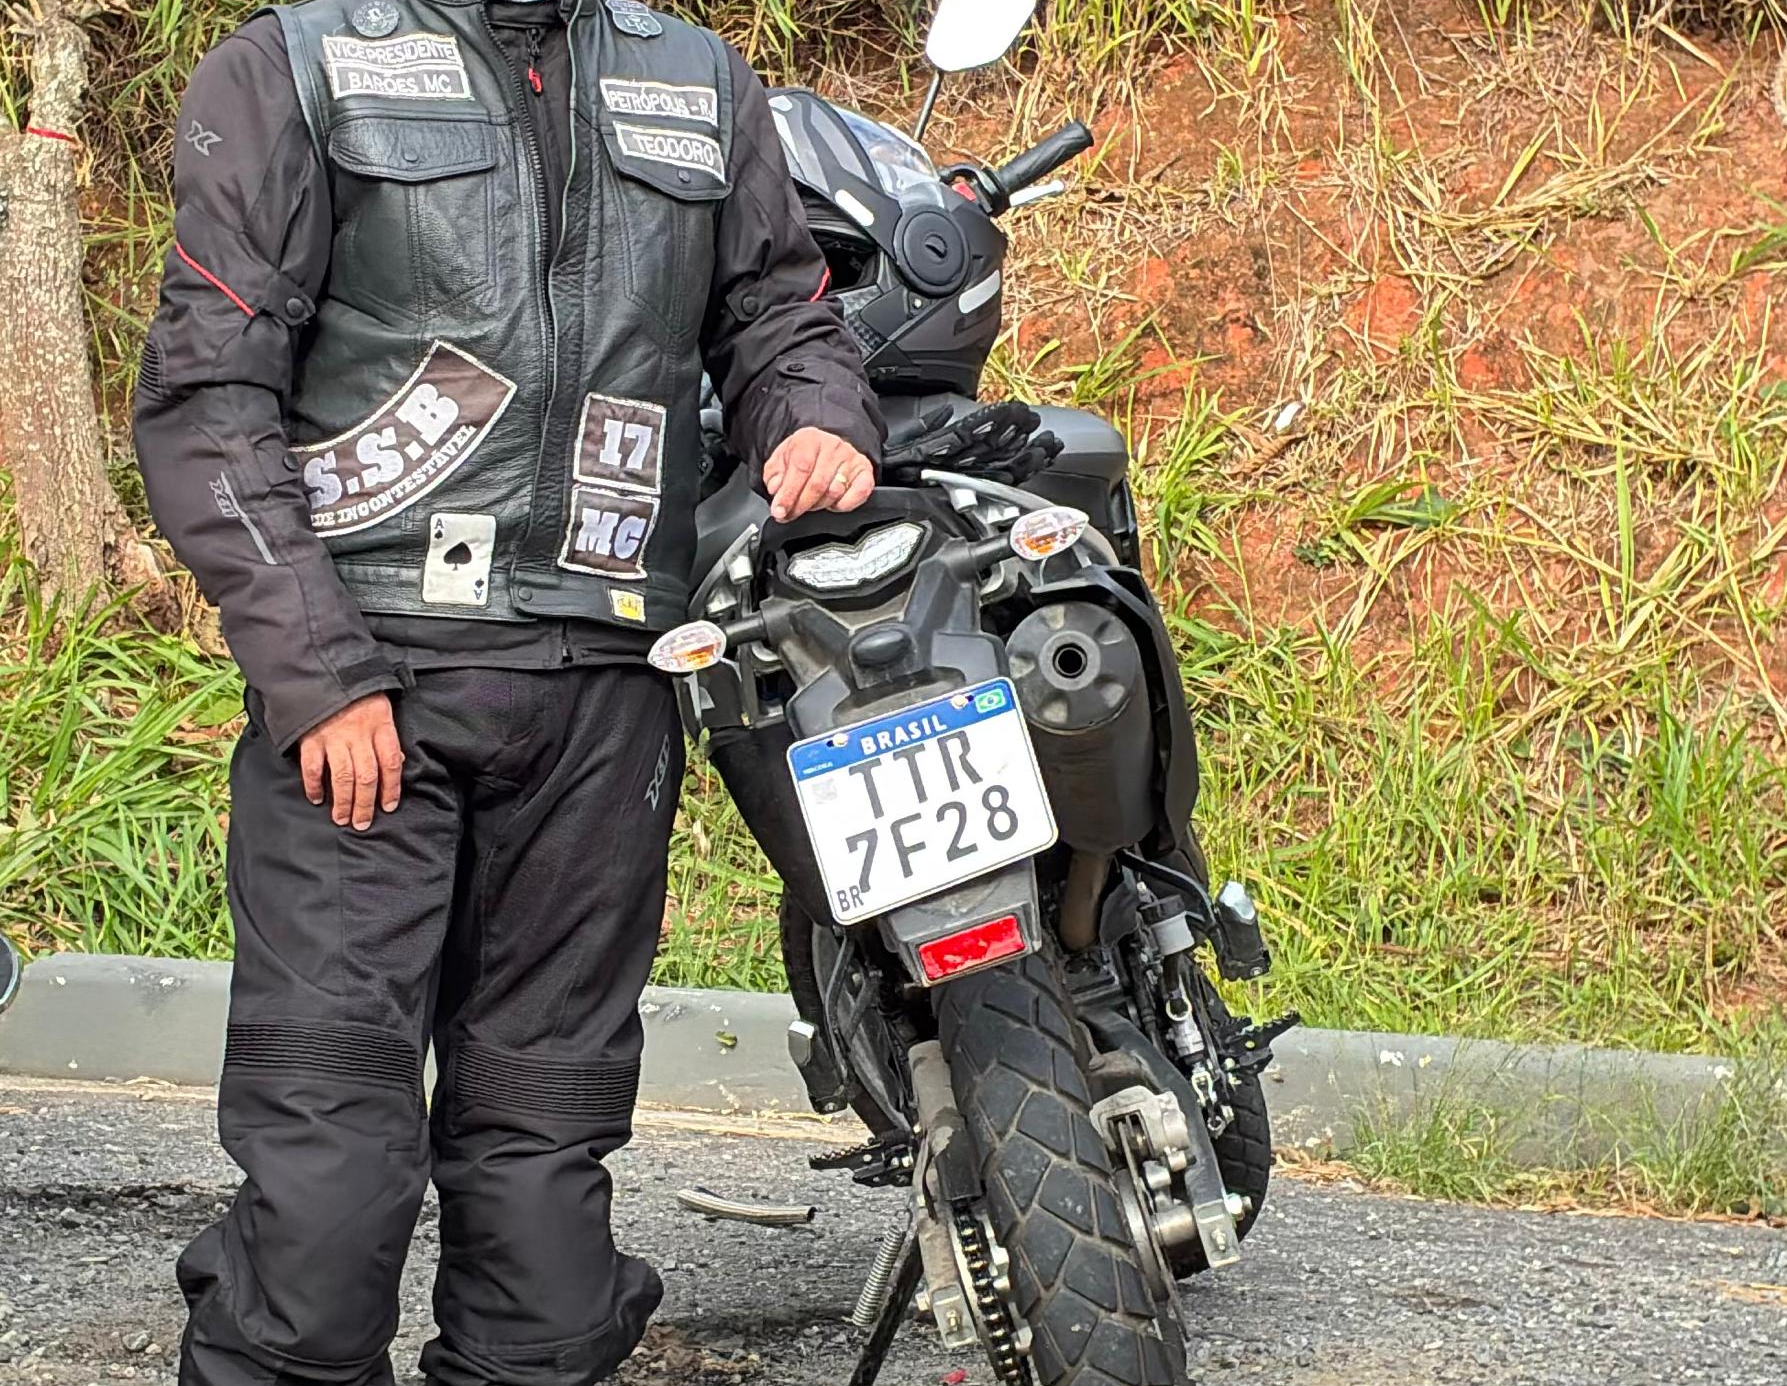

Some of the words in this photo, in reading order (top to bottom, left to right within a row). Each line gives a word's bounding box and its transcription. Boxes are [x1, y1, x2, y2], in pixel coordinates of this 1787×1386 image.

[330, 39, 455, 63] VICEPRESIDENTE
[348, 71, 418, 93] BARÕES
[423, 73, 452, 93] MC
[632, 133, 714, 166] TEODORO
[599, 419, 653, 470] 17
[575, 507, 647, 560] MC
[861, 714, 948, 755] BRASIL
[849, 730, 983, 819] TTR
[845, 784, 1019, 894] 7F28
[836, 884, 864, 912] BR
